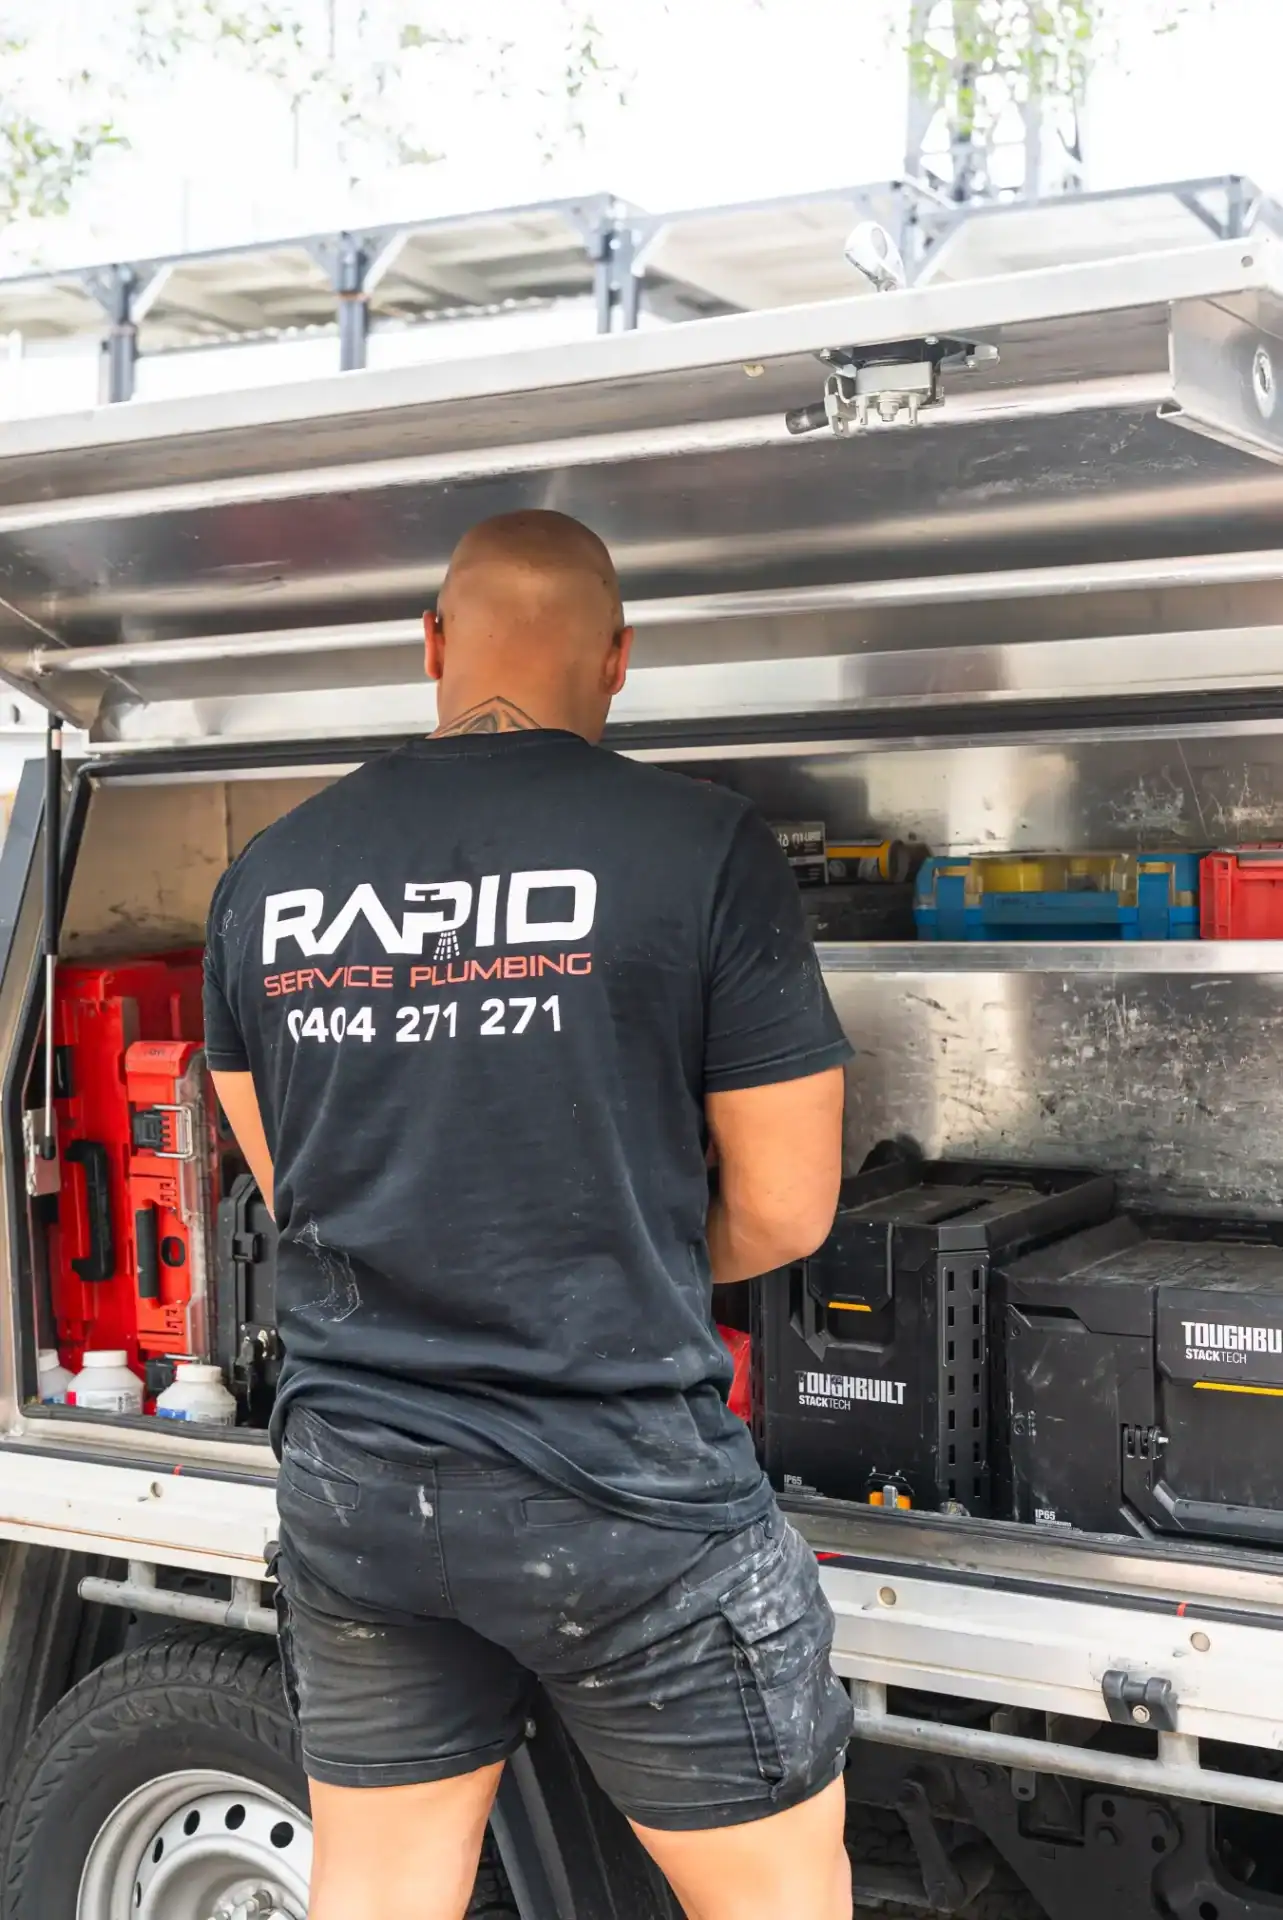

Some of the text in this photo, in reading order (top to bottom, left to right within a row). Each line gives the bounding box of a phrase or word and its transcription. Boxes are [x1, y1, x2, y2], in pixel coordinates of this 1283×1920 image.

[262, 869, 597, 965] RAPID
[264, 953, 592, 997] SERVICE PLUMBING
[287, 995, 561, 1043] 0404 271 271
[1185, 1347, 1247, 1364] STACKTECH
[795, 1370, 907, 1405] TOUGHBUILT
[799, 1395, 851, 1411] STACKTECH
[783, 1474, 802, 1486] IP65
[1035, 1508, 1056, 1520] IP65
